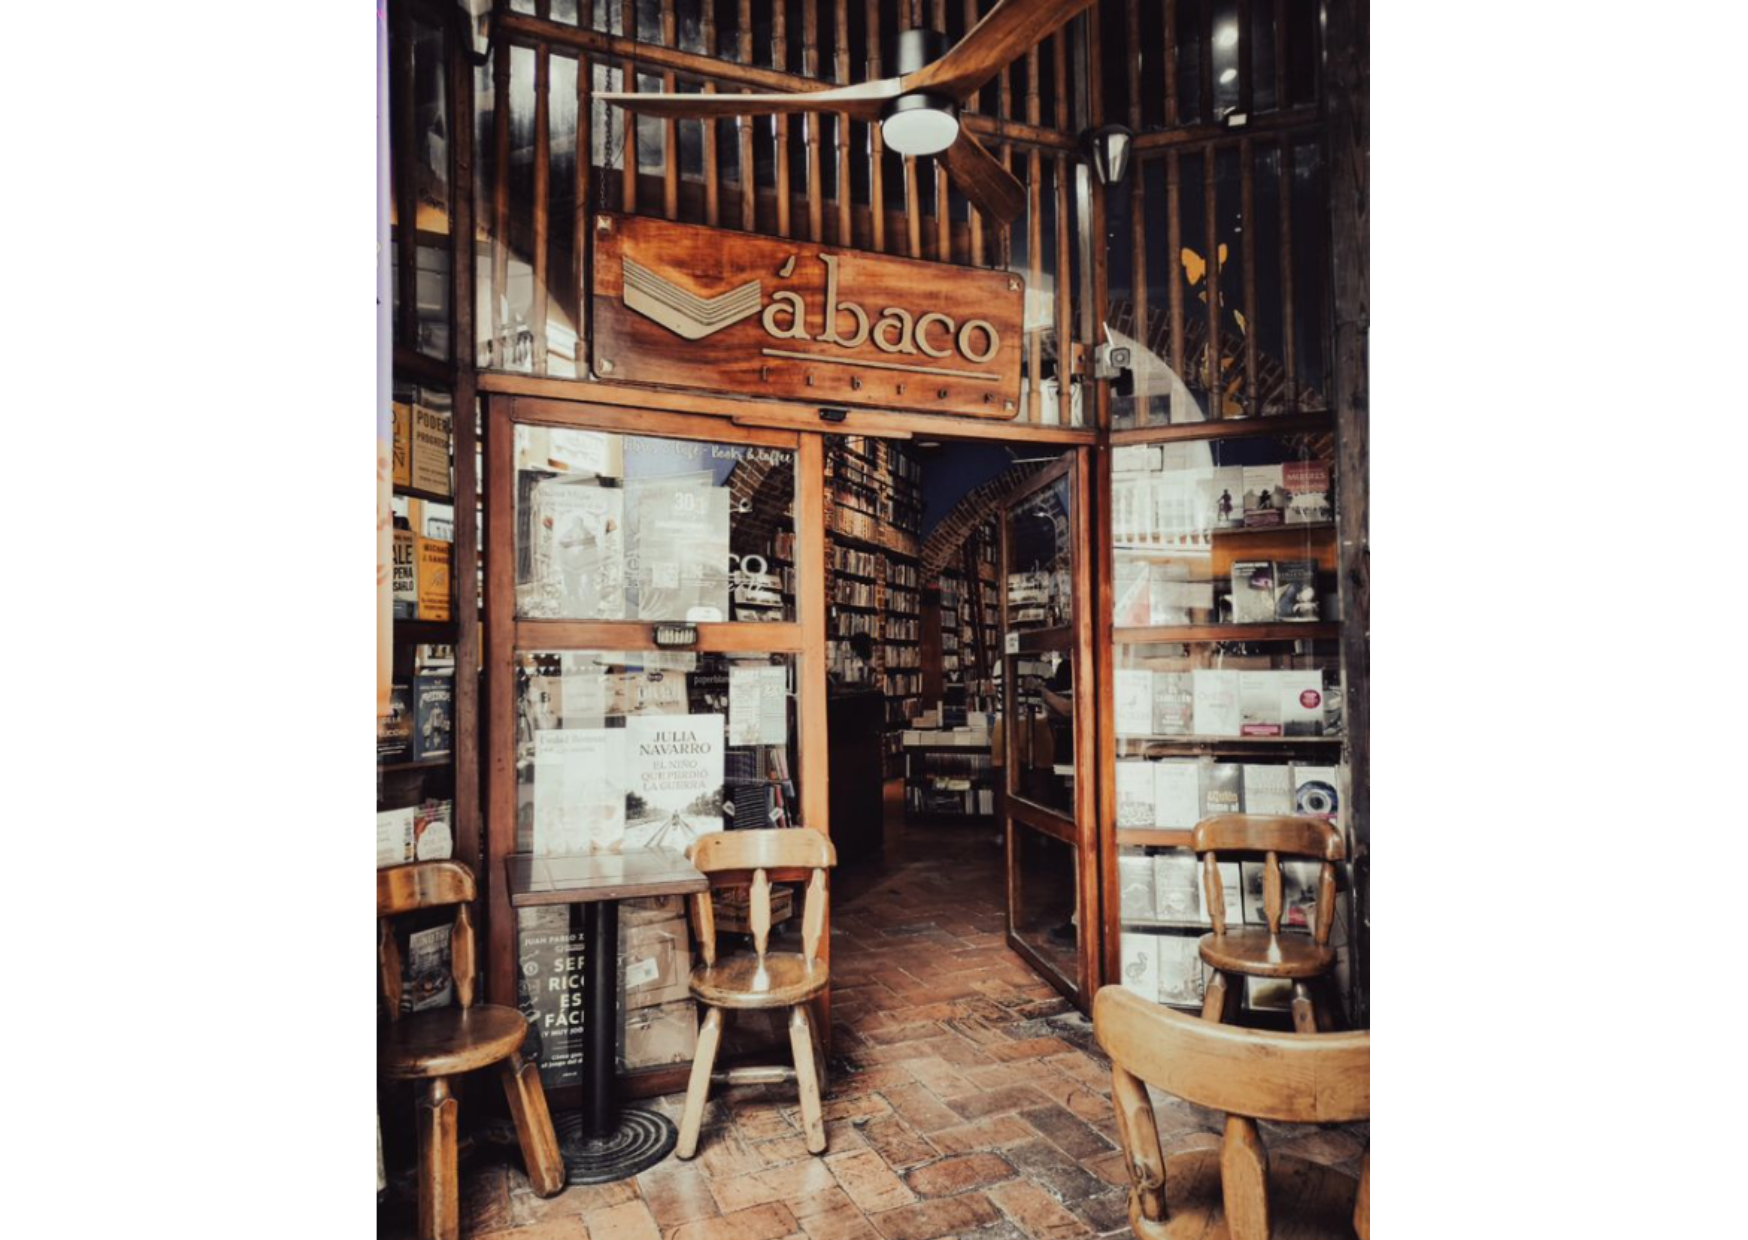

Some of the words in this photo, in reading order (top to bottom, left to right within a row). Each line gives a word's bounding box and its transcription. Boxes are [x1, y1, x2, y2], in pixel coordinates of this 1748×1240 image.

[762, 252, 1001, 363] ábaco
[693, 676, 729, 688] paperblan
[653, 731, 697, 743] JULIA
[639, 743, 712, 756] NAVARRO
[653, 760, 667, 770] EL
[641, 771, 666, 782] QUE
[642, 782, 658, 792] LA
[659, 780, 707, 790] GUERRA
[525, 937, 547, 946] JUAN
[549, 935, 576, 945] PABLO
[548, 975, 585, 991] RIC
[560, 993, 583, 1008] ES
[544, 1009, 585, 1028] FÁCI
